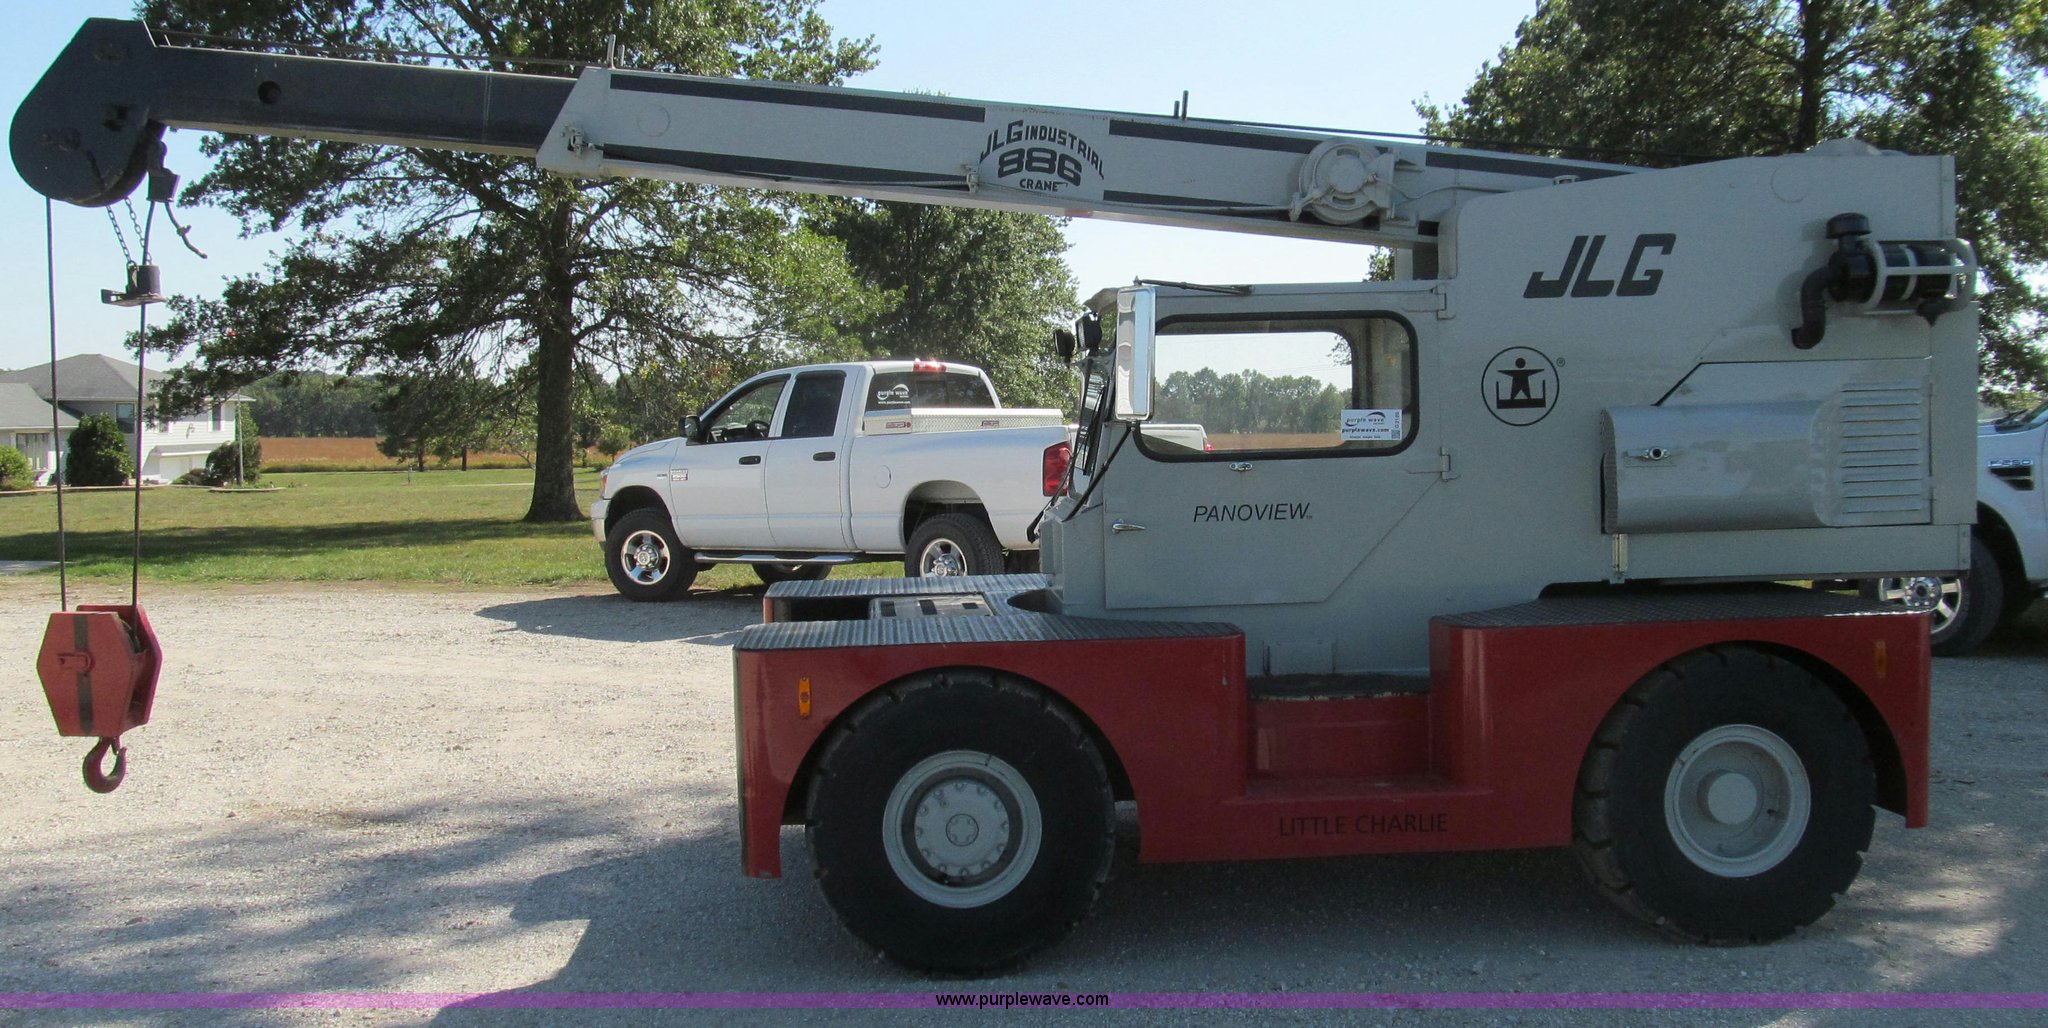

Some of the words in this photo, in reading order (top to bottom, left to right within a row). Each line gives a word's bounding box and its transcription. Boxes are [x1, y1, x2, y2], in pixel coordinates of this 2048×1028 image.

[980, 120, 1024, 163] JLG
[1025, 125, 1104, 180] INDUSTRIAL
[998, 147, 1082, 186] 886
[1019, 178, 1059, 192] CRANE
[1523, 233, 1676, 298] JLG
[1193, 502, 1311, 522] PANOVIEW
[1280, 816, 1346, 836] LITTLE
[1355, 813, 1448, 834] CHARLIE
